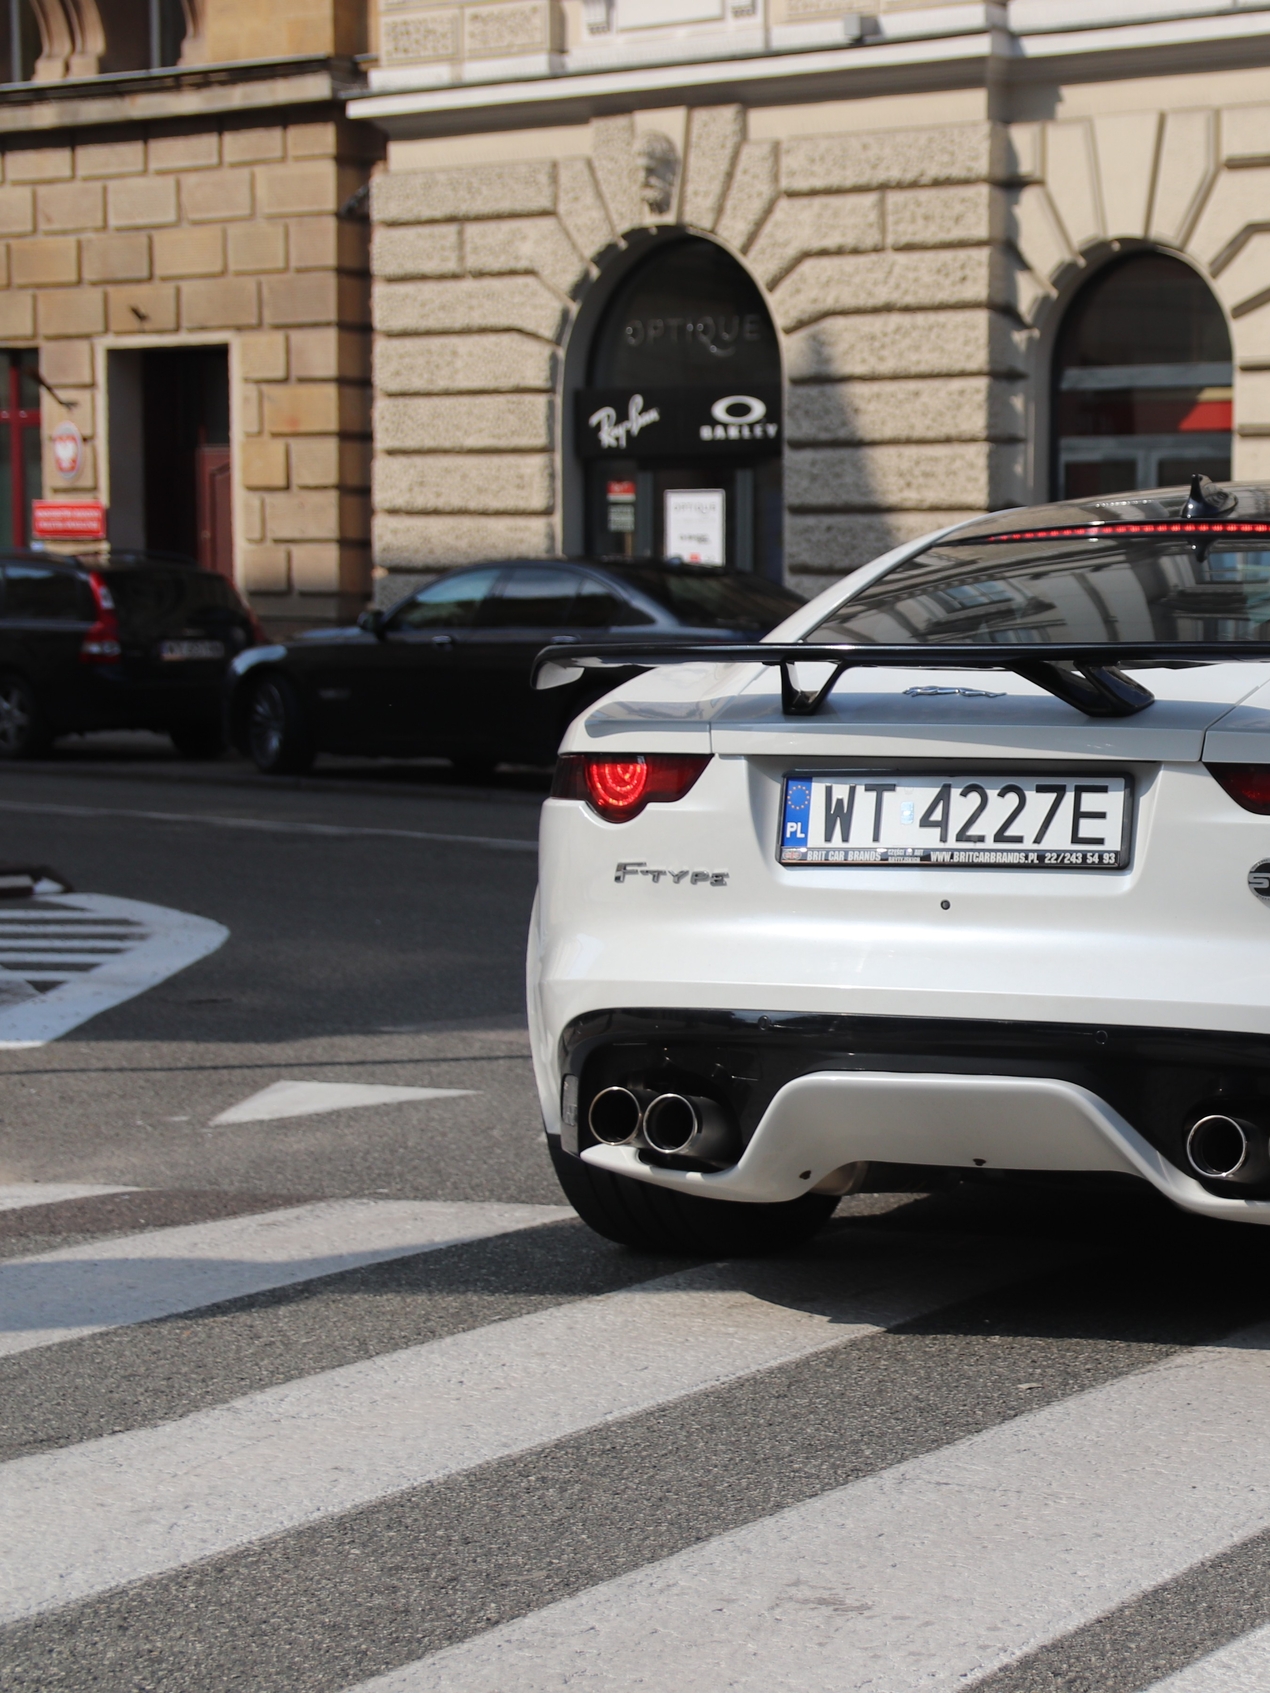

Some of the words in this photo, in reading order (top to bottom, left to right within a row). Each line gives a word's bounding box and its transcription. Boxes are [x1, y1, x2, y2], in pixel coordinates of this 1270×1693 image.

[626, 314, 761, 357] OPTIQUE
[699, 423, 779, 441] OAKLEY
[824, 783, 896, 843] WT
[919, 783, 1109, 845] 4227E
[786, 822, 805, 838] PL
[807, 850, 825, 861] BRIT
[828, 851, 844, 861] CAR
[848, 850, 881, 862] BRANDS
[930, 852, 1039, 863] WWW.BRITCARBRANDS.PL
[1044, 852, 1082, 864] 22/243
[1086, 853, 1099, 864] 54
[1102, 853, 1116, 864] 93
